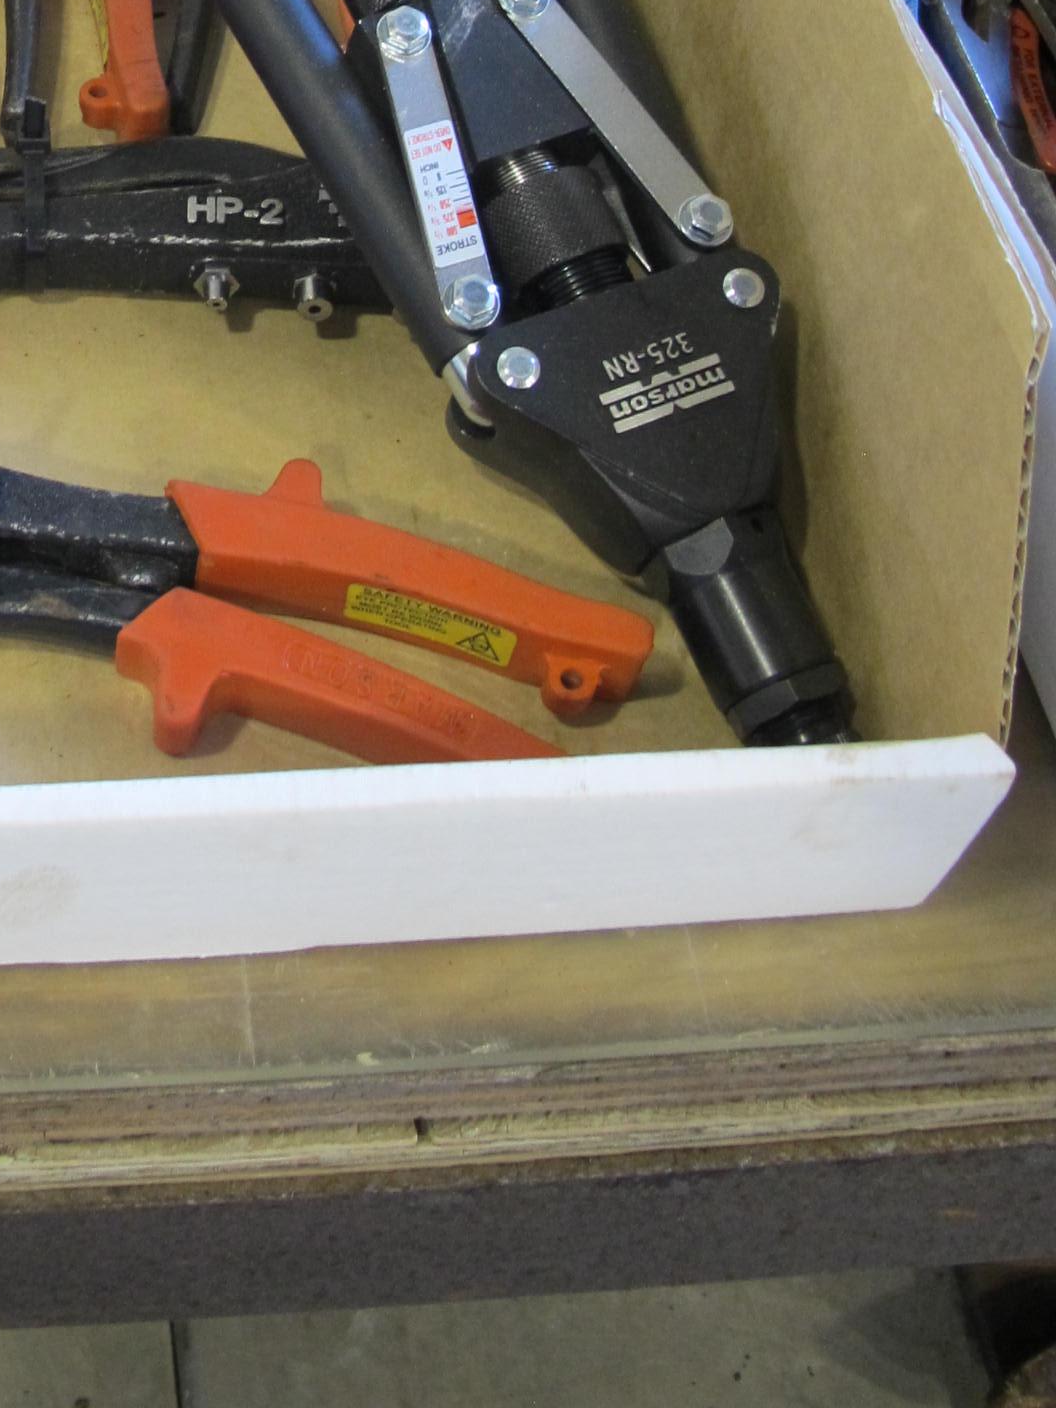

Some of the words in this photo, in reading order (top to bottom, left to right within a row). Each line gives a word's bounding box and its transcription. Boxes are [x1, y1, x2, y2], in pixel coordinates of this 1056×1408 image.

[187, 195, 284, 225] HP-2
[435, 234, 479, 256] STROKE
[602, 332, 694, 381] 325-RN
[609, 366, 726, 419] marson
[363, 587, 423, 609] SAFETY
[429, 604, 501, 637] WARNING
